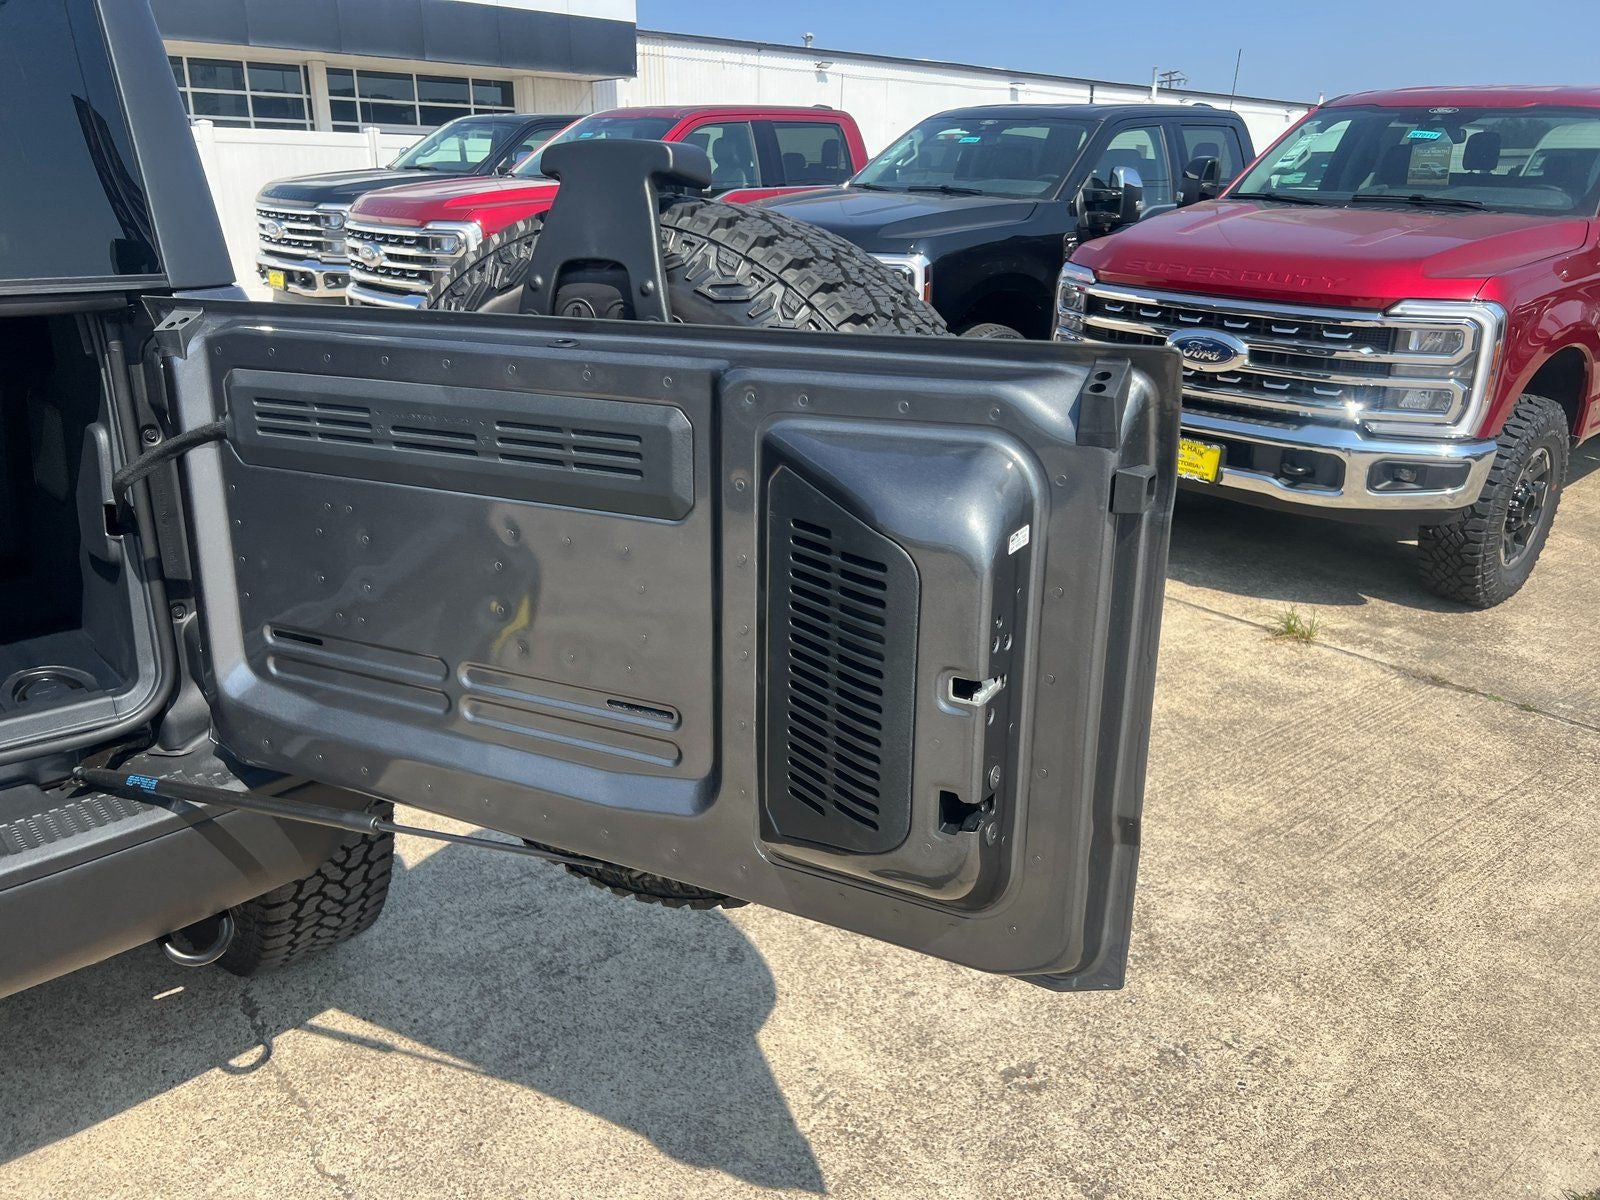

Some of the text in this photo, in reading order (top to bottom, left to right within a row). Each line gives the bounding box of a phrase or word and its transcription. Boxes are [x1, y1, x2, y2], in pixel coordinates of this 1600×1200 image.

[1124, 259, 1348, 289] SUPER DUTY
[1183, 340, 1222, 362] Ford
